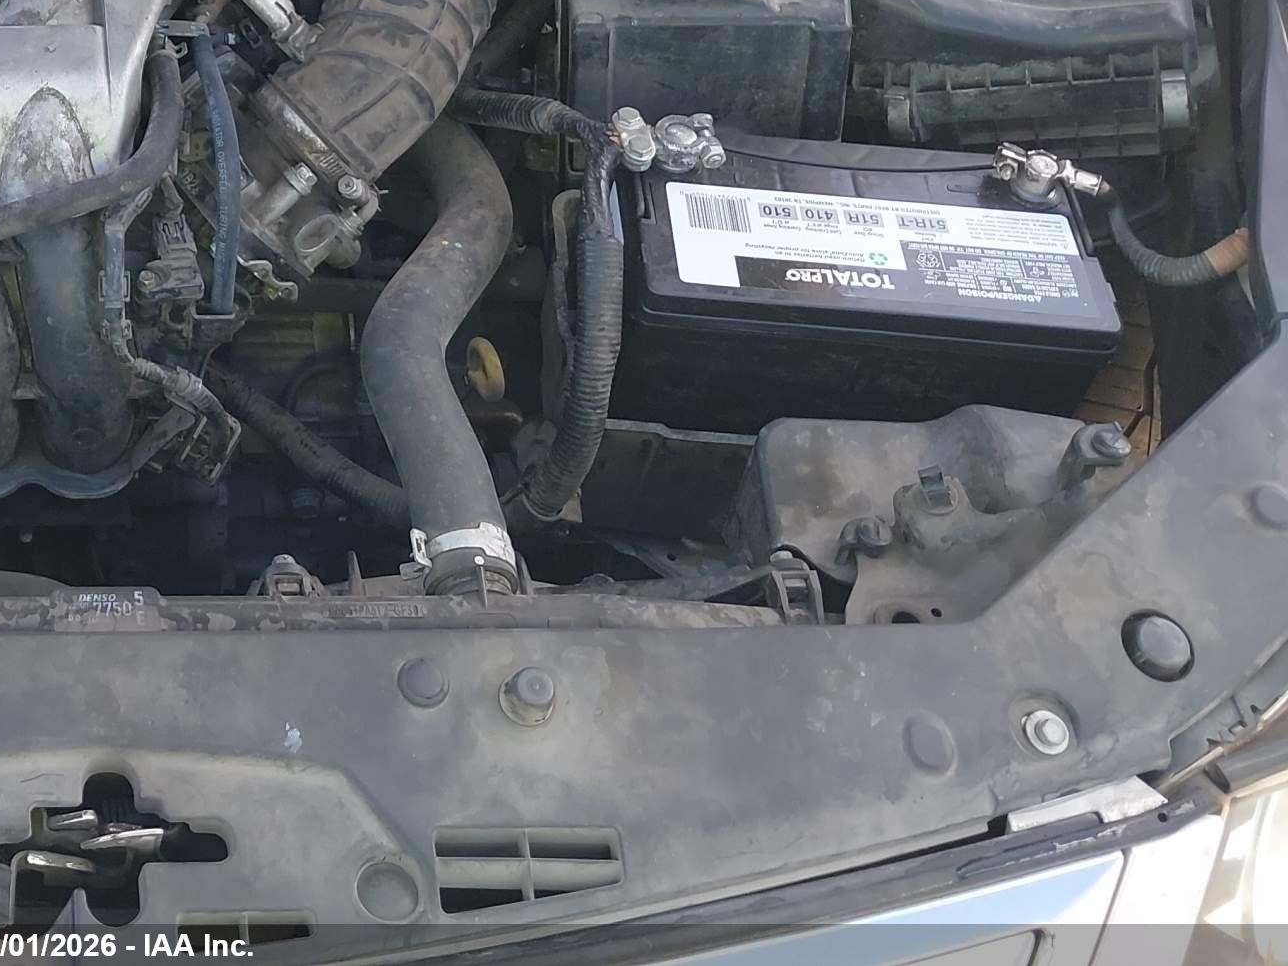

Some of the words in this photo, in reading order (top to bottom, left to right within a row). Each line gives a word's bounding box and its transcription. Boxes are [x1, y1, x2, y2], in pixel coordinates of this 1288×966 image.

[762, 205, 791, 217] 510
[805, 208, 833, 221] 410
[847, 213, 879, 225] 51R
[900, 217, 946, 230] 51R-T
[786, 267, 895, 290] TOTALPRO
[78, 593, 117, 602] DENSO
[133, 590, 144, 606] 5
[93, 600, 132, 617] 7750
